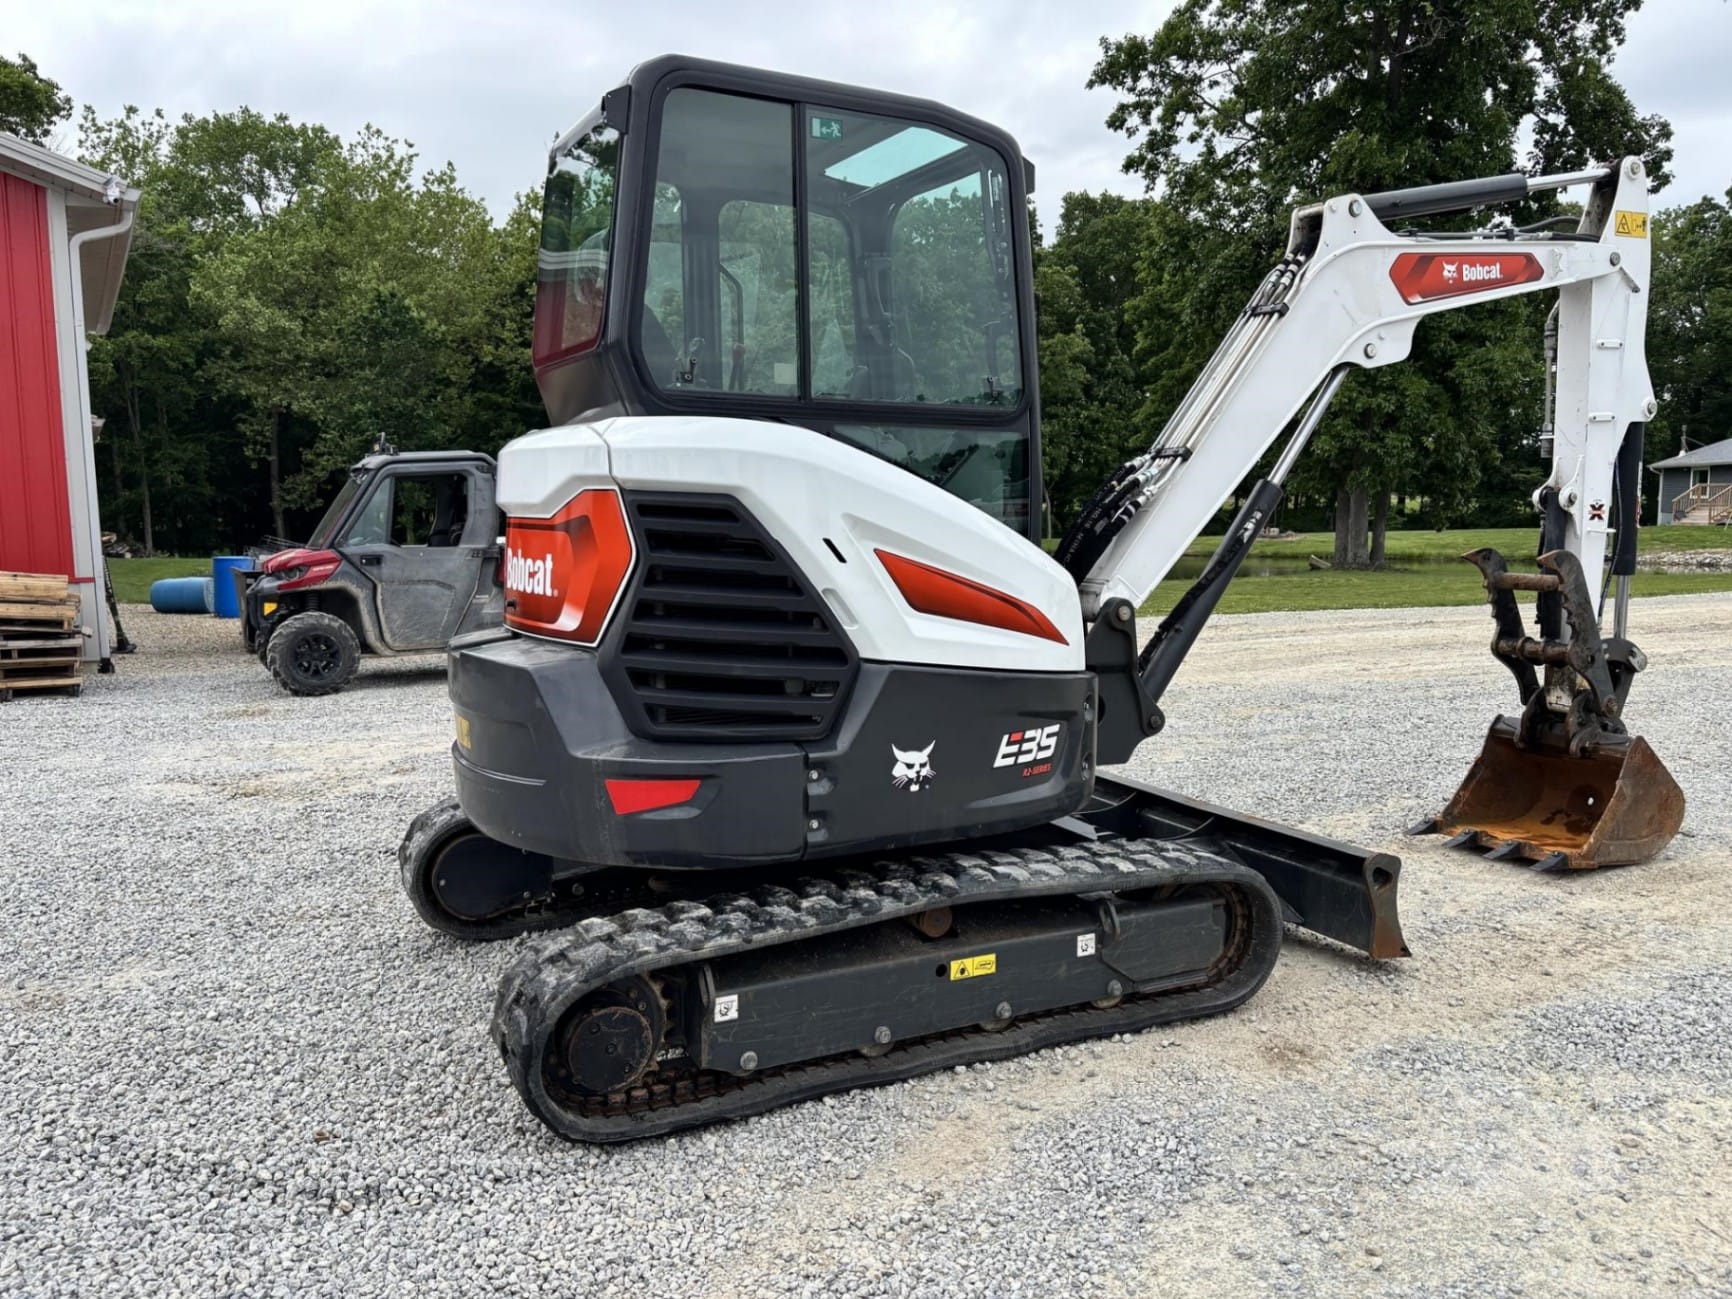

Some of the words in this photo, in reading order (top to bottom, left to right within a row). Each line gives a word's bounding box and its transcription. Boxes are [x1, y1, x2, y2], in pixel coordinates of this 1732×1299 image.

[1462, 262, 1500, 281] Bobcat
[507, 547, 553, 597] Bobcat
[993, 724, 1060, 768] E35
